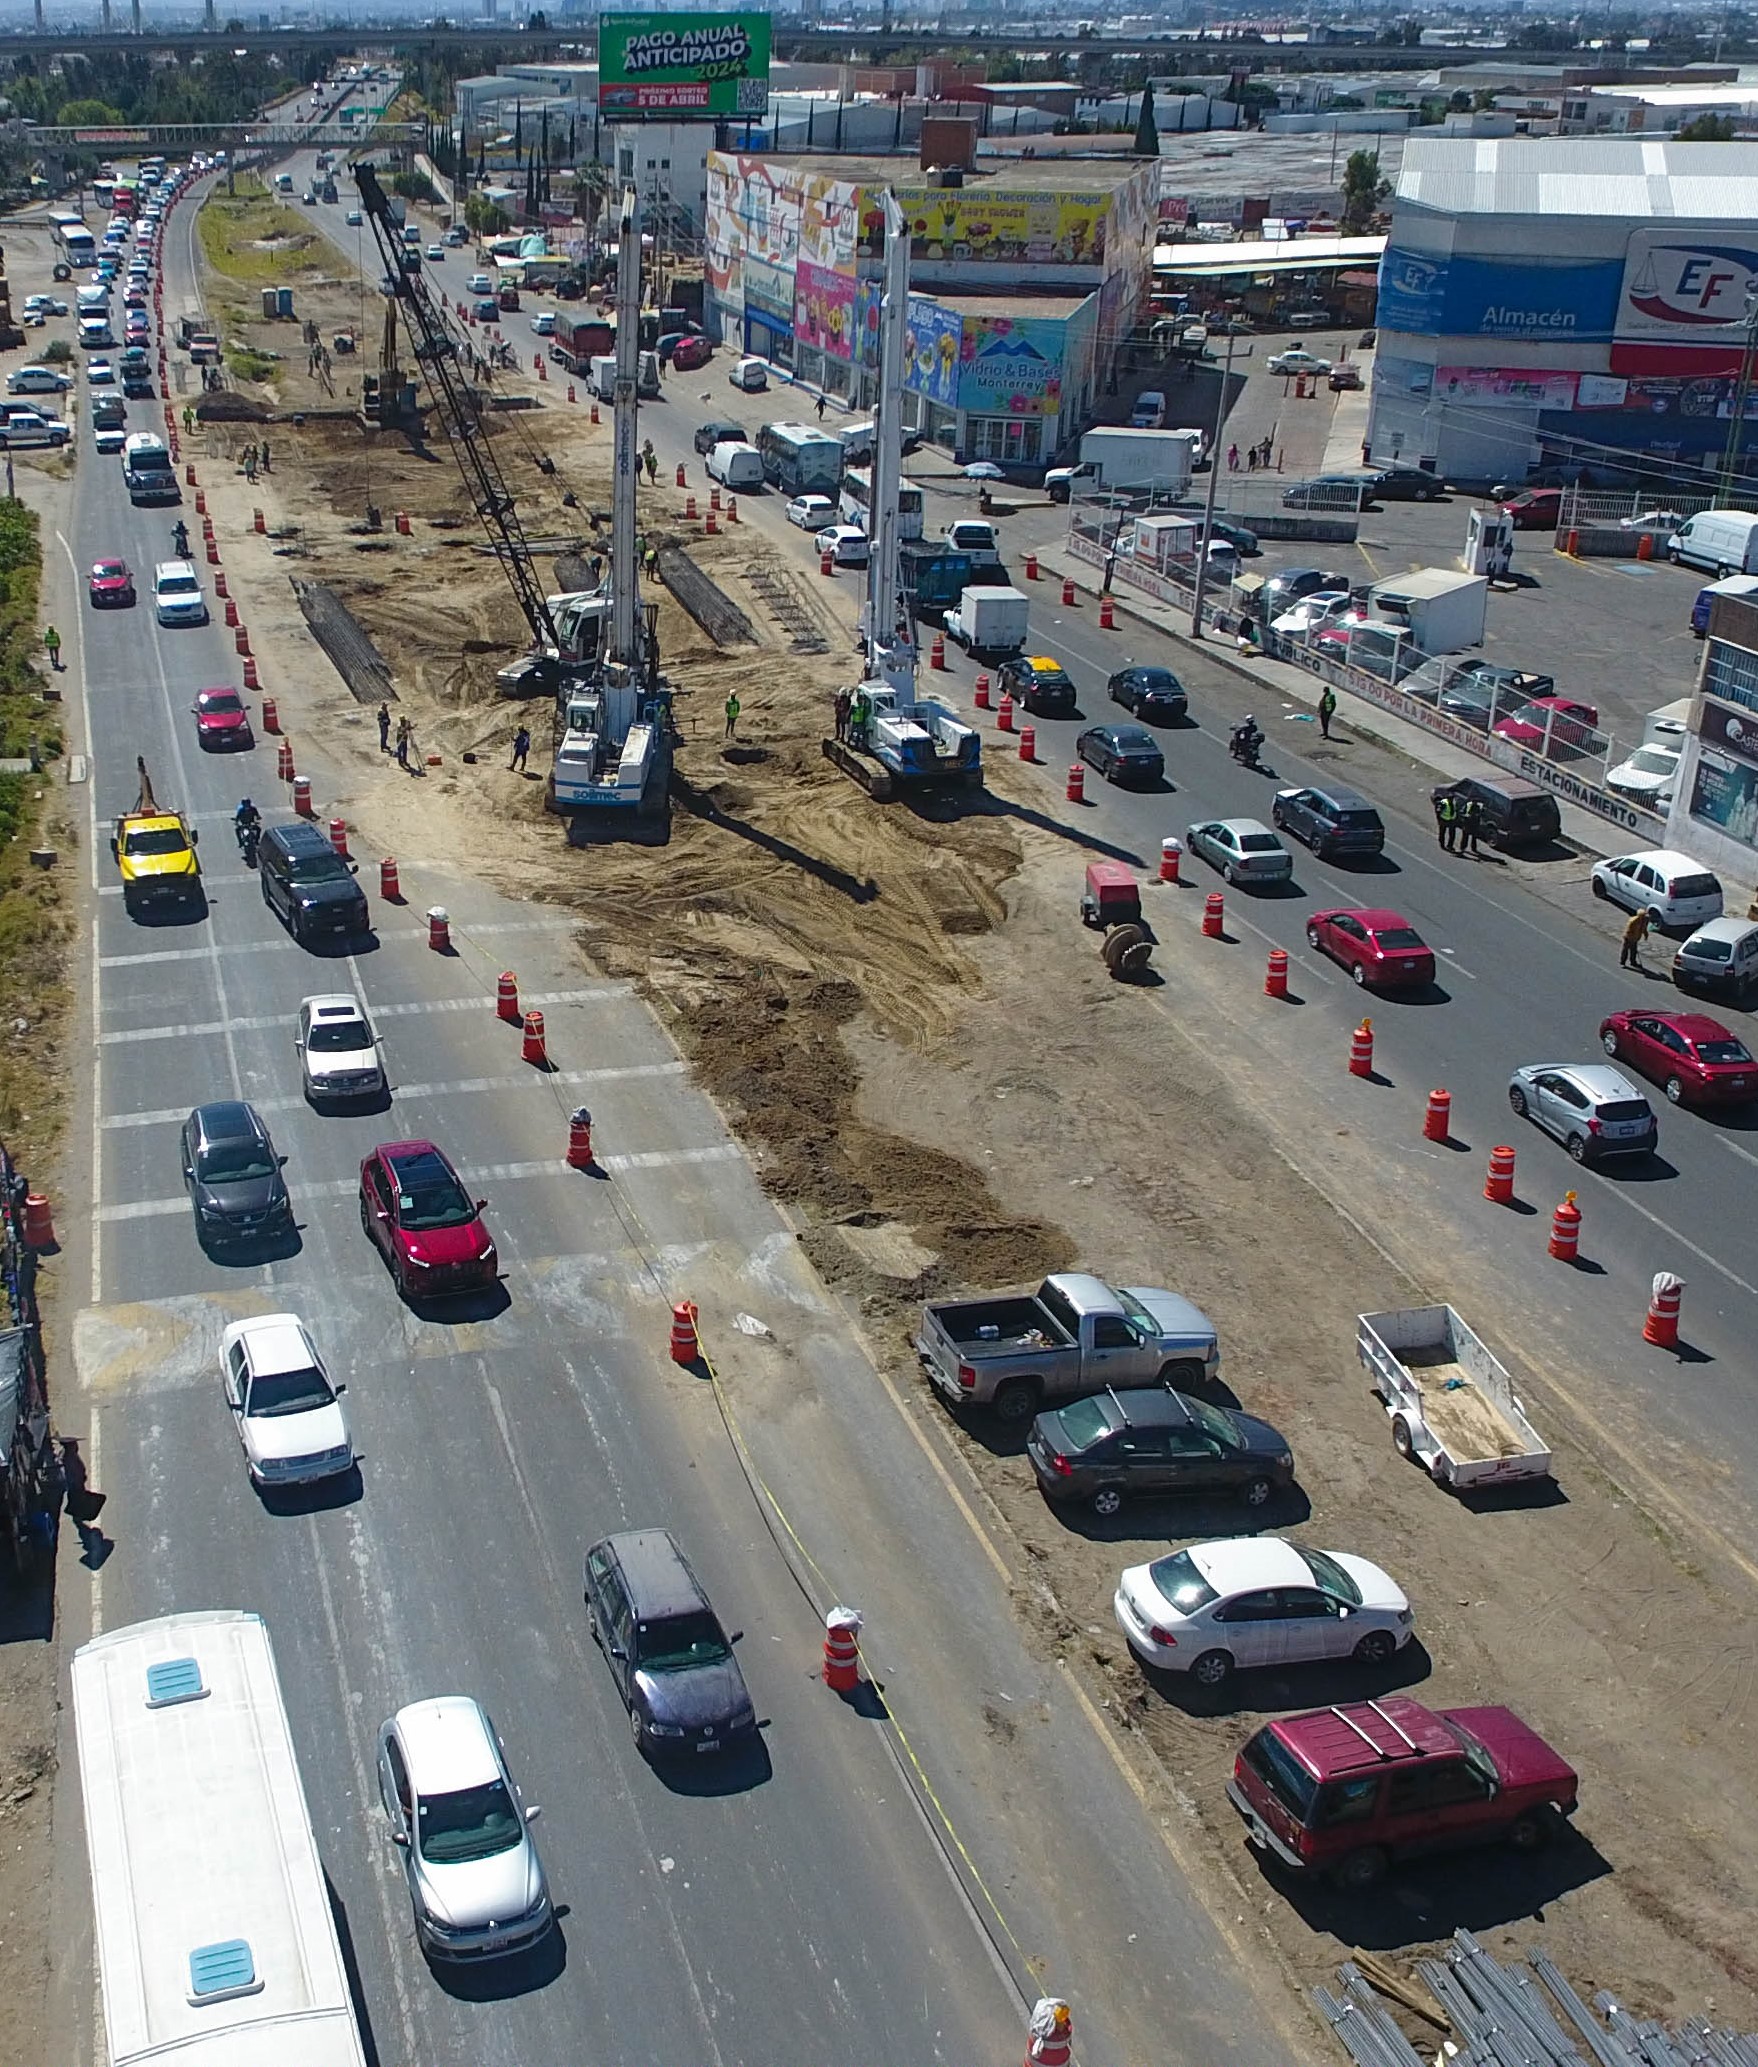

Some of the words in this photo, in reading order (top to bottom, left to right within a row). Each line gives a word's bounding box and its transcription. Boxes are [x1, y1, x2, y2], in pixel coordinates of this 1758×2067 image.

[626, 31, 676, 51] PAGO
[680, 23, 744, 46] ANUAL
[623, 40, 746, 70] ANTICIPADO
[696, 57, 743, 79] 2024
[638, 94, 646, 105] 5
[648, 94, 666, 106] DE
[669, 94, 708, 105] ABRIL
[924, 192, 947, 203] para
[1071, 194, 1100, 207] Hogar
[1482, 306, 1576, 327] Almacén
[961, 361, 1002, 377] Vidrio
[1006, 365, 1016, 378] &
[1018, 363, 1061, 378] Bases
[977, 377, 1042, 392] Monterrey
[1383, 690, 1404, 713] POR
[1403, 699, 1418, 719] LA
[1419, 708, 1463, 743] PRIMERA
[1464, 733, 1493, 758] HORA
[1520, 755, 1638, 828] ESTACIONAMIENTO
